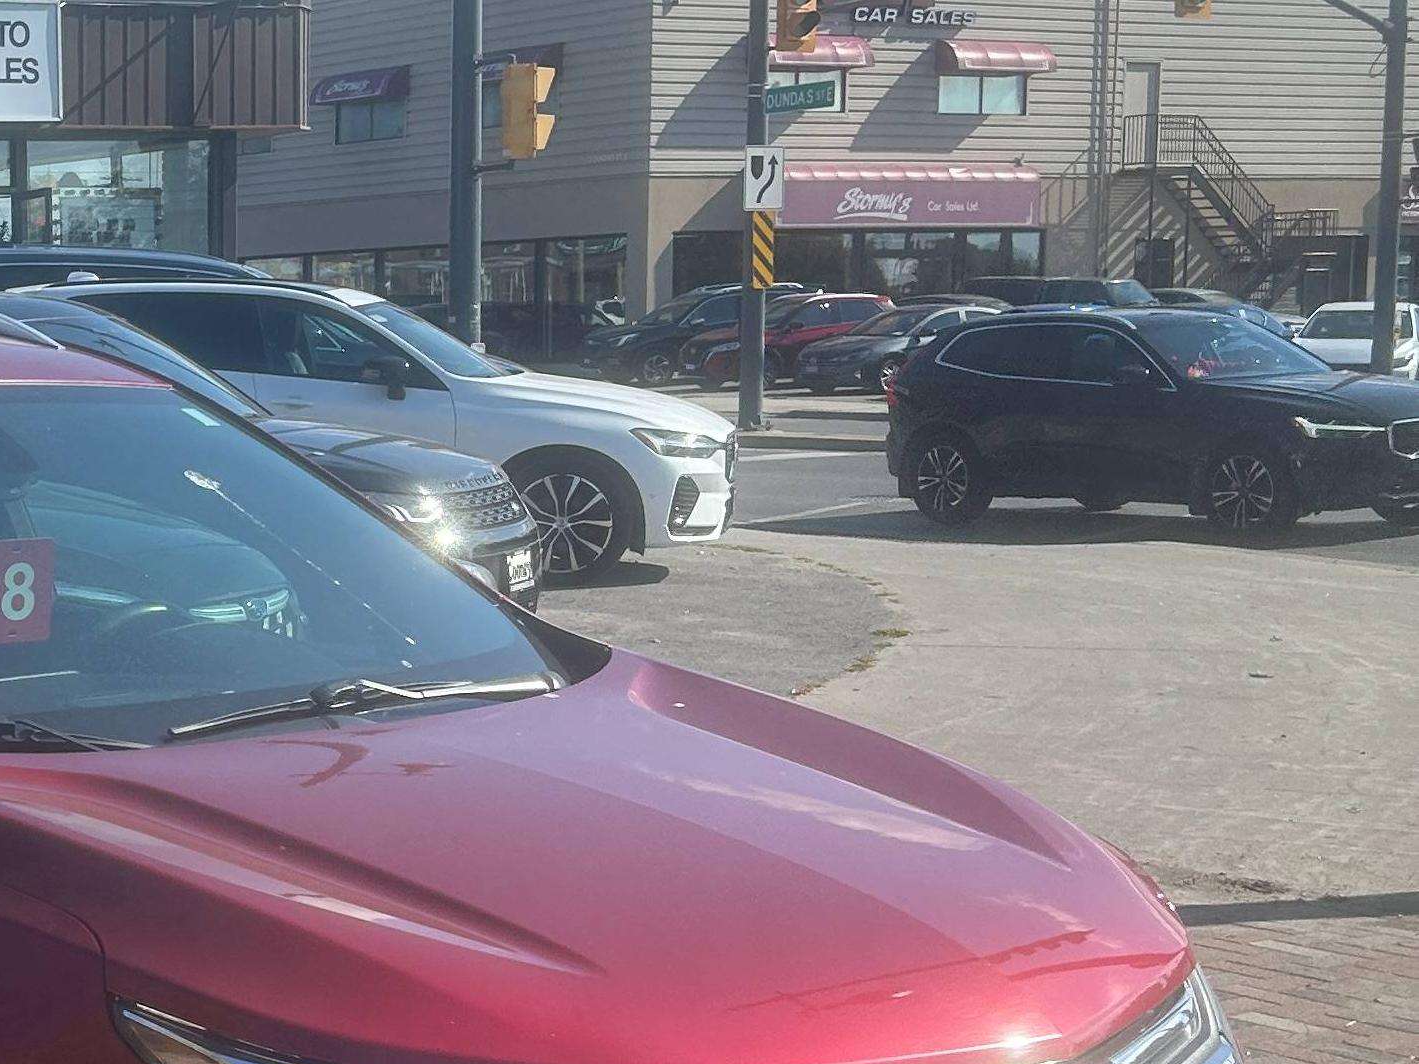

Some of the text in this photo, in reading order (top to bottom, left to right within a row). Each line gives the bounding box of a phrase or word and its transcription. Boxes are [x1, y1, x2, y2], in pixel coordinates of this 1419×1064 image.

[854, 7, 975, 25] CAR SALES
[766, 89, 814, 109] DUNDAS
[927, 200, 942, 212] Car
[945, 200, 965, 212] Sales
